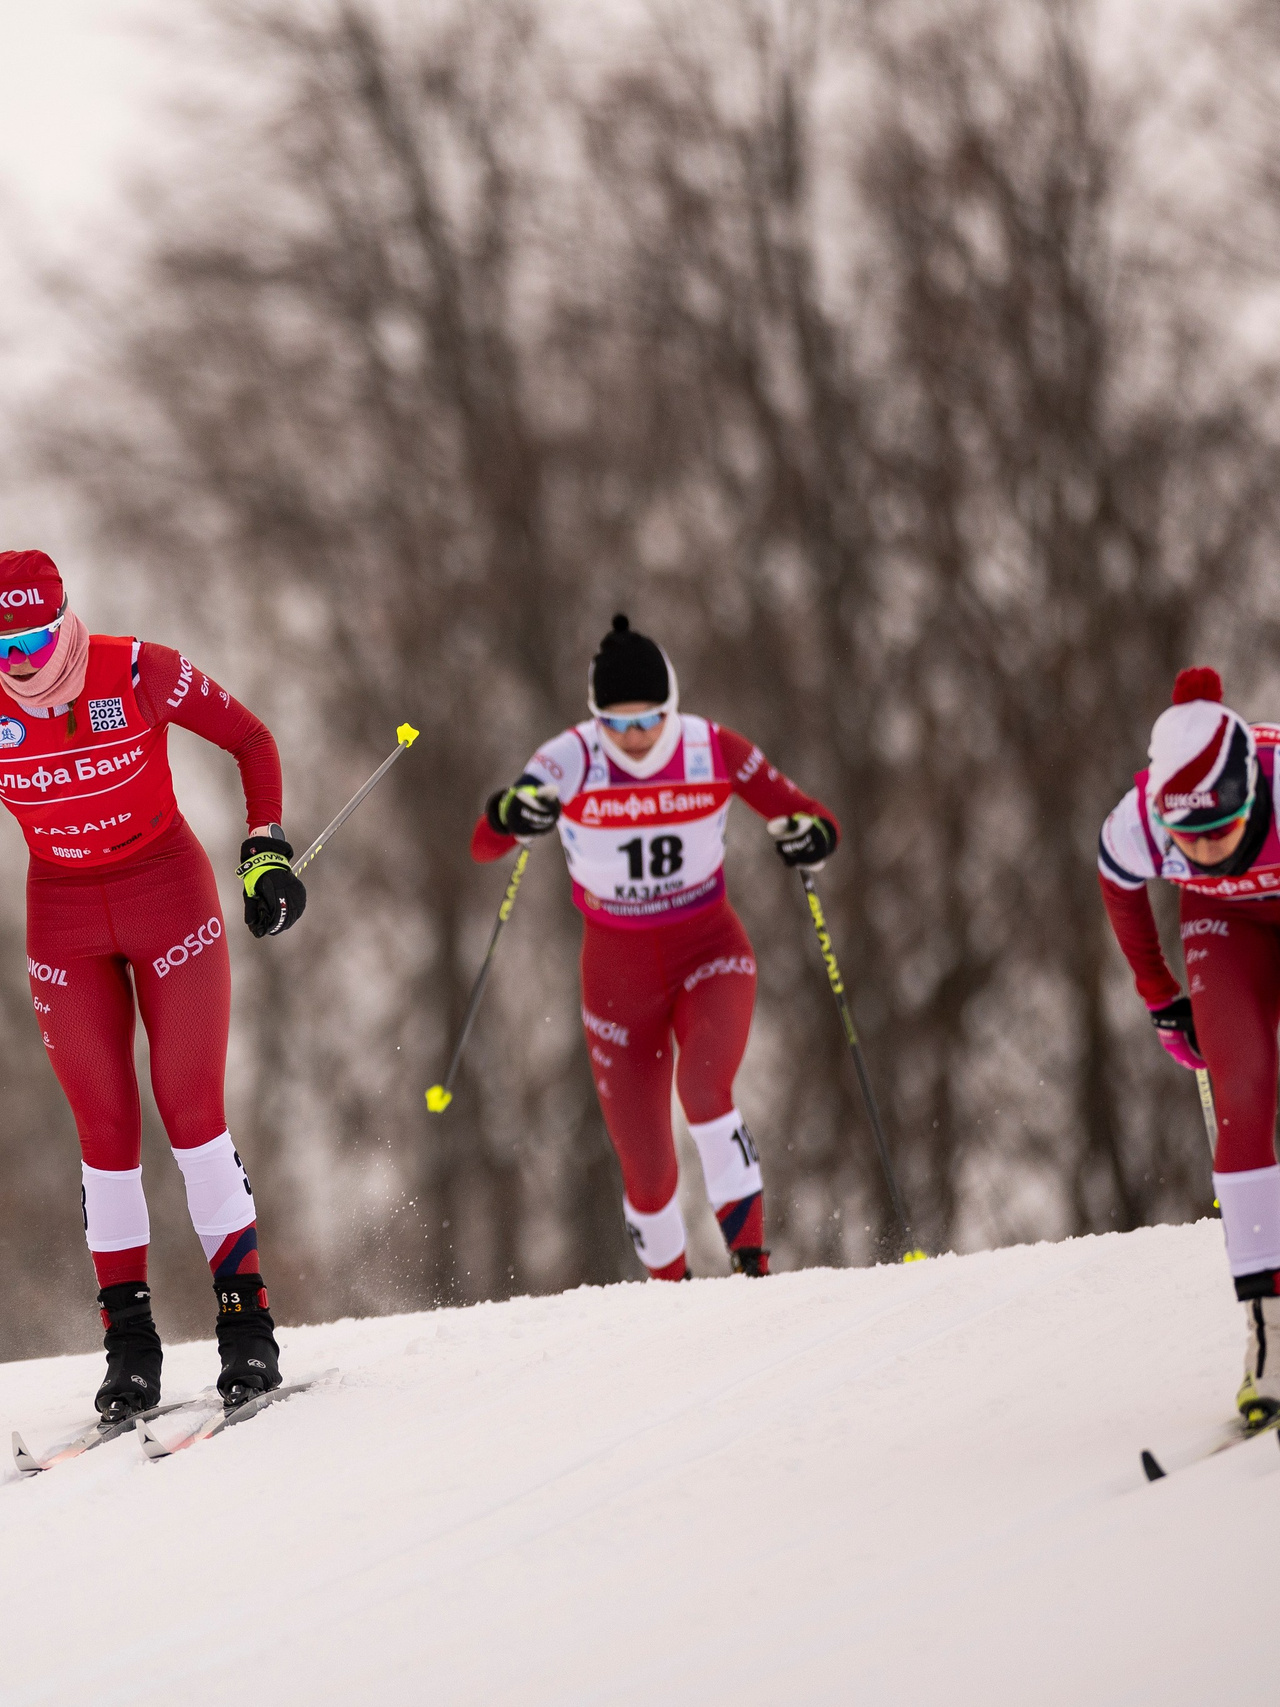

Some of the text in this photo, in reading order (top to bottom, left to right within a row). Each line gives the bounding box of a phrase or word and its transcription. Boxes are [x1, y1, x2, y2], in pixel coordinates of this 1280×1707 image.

[166, 653, 193, 708] LUKO
[89, 698, 121, 709] СЕЗОН
[90, 707, 123, 720] 2023
[92, 717, 127, 731] 2024
[74, 745, 144, 781] Банк
[32, 812, 132, 835] КАЗАНЬ
[580, 792, 657, 825] Альфа
[658, 790, 716, 815] Банк
[52, 846, 84, 859] BOSCO
[617, 835, 683, 880] 18
[152, 916, 222, 979] BOSCO
[26, 954, 68, 987] UKOIL
